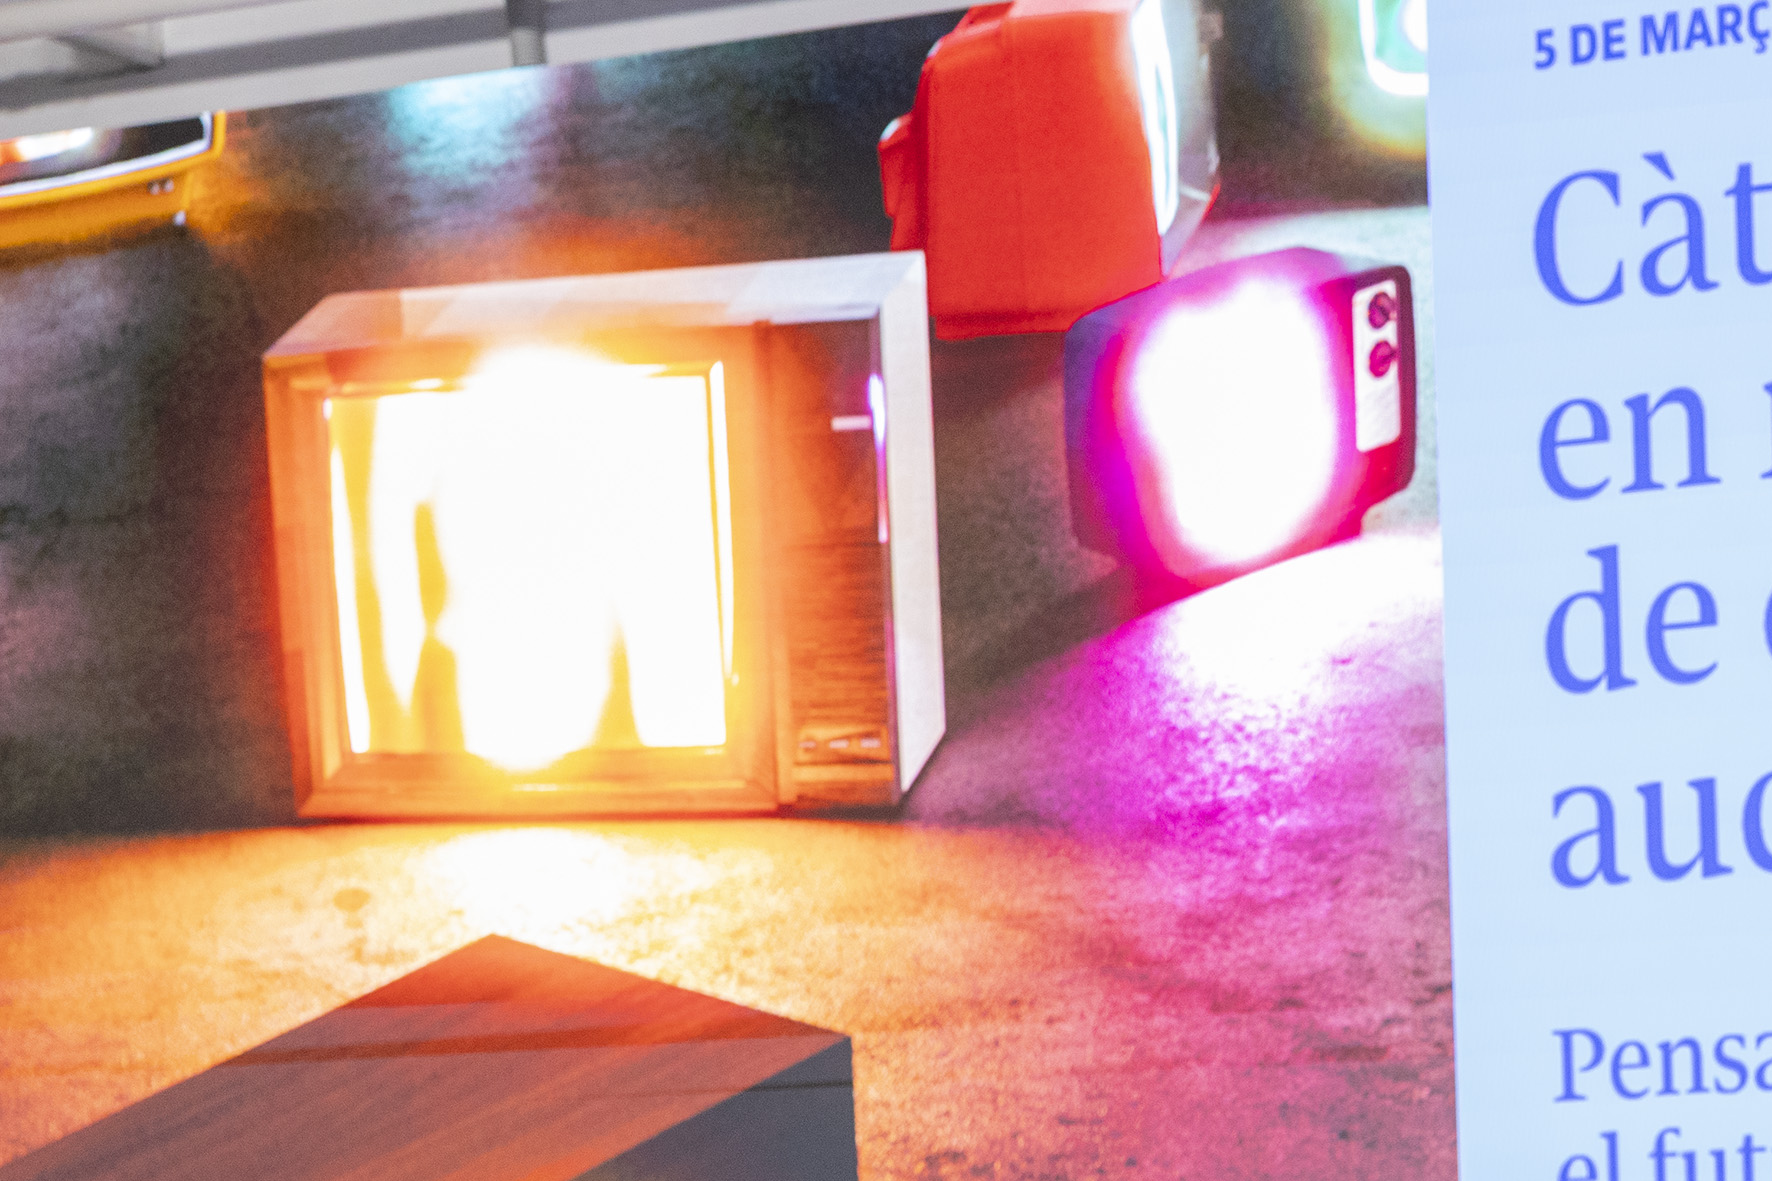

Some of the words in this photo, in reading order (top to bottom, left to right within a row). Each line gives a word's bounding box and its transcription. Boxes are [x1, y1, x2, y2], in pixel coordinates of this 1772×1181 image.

[1533, 27, 1558, 71] 5
[1569, 18, 1628, 67] DE
[1639, 0, 1772, 56] MARÇ
[1538, 386, 1722, 501] en
[1544, 543, 1719, 695] de
